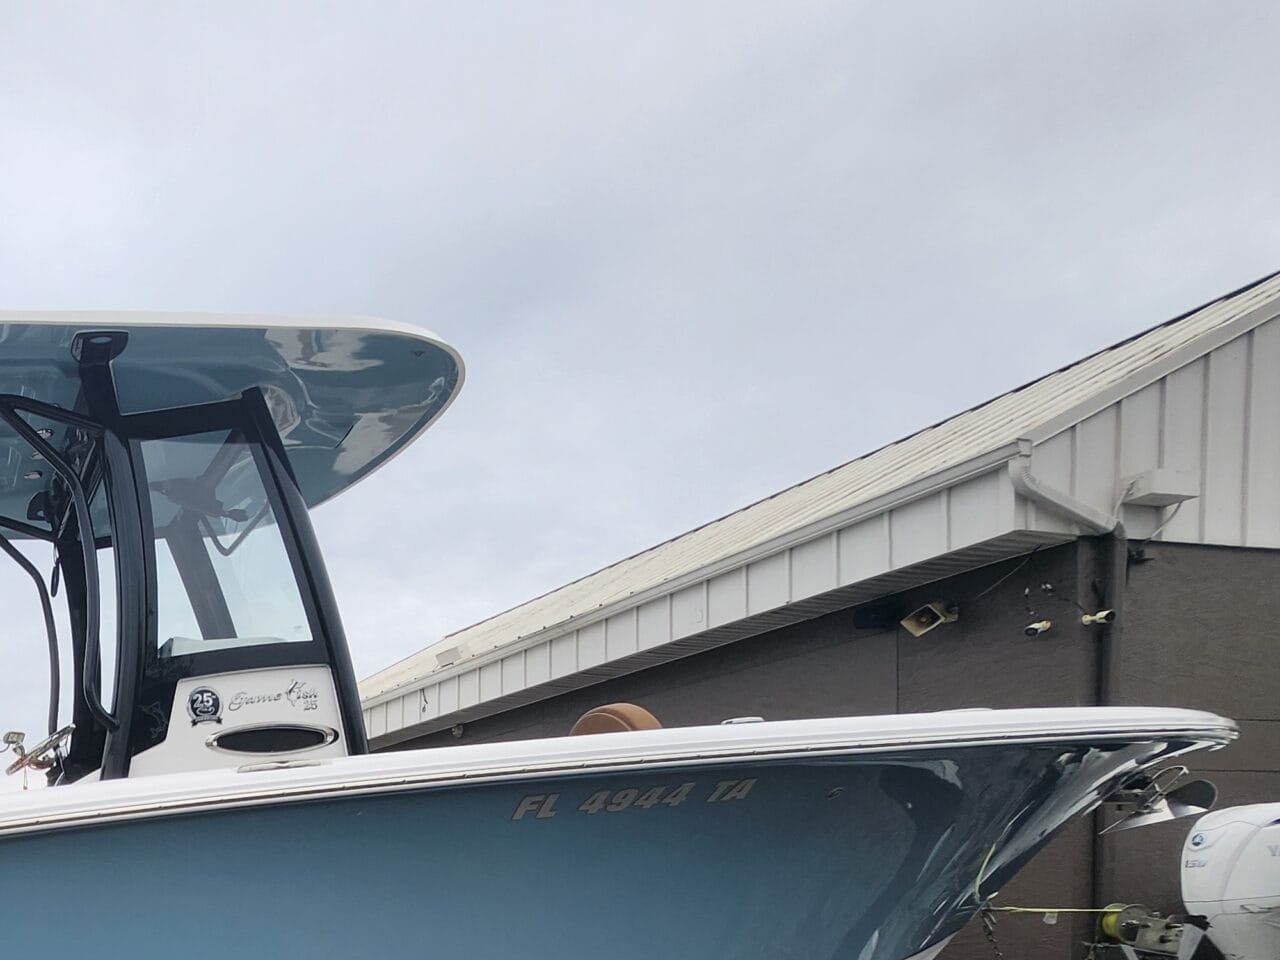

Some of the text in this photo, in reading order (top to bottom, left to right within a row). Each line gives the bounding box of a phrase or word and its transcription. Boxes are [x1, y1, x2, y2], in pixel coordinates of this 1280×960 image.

[511, 778, 758, 821] FL 4944 TA
